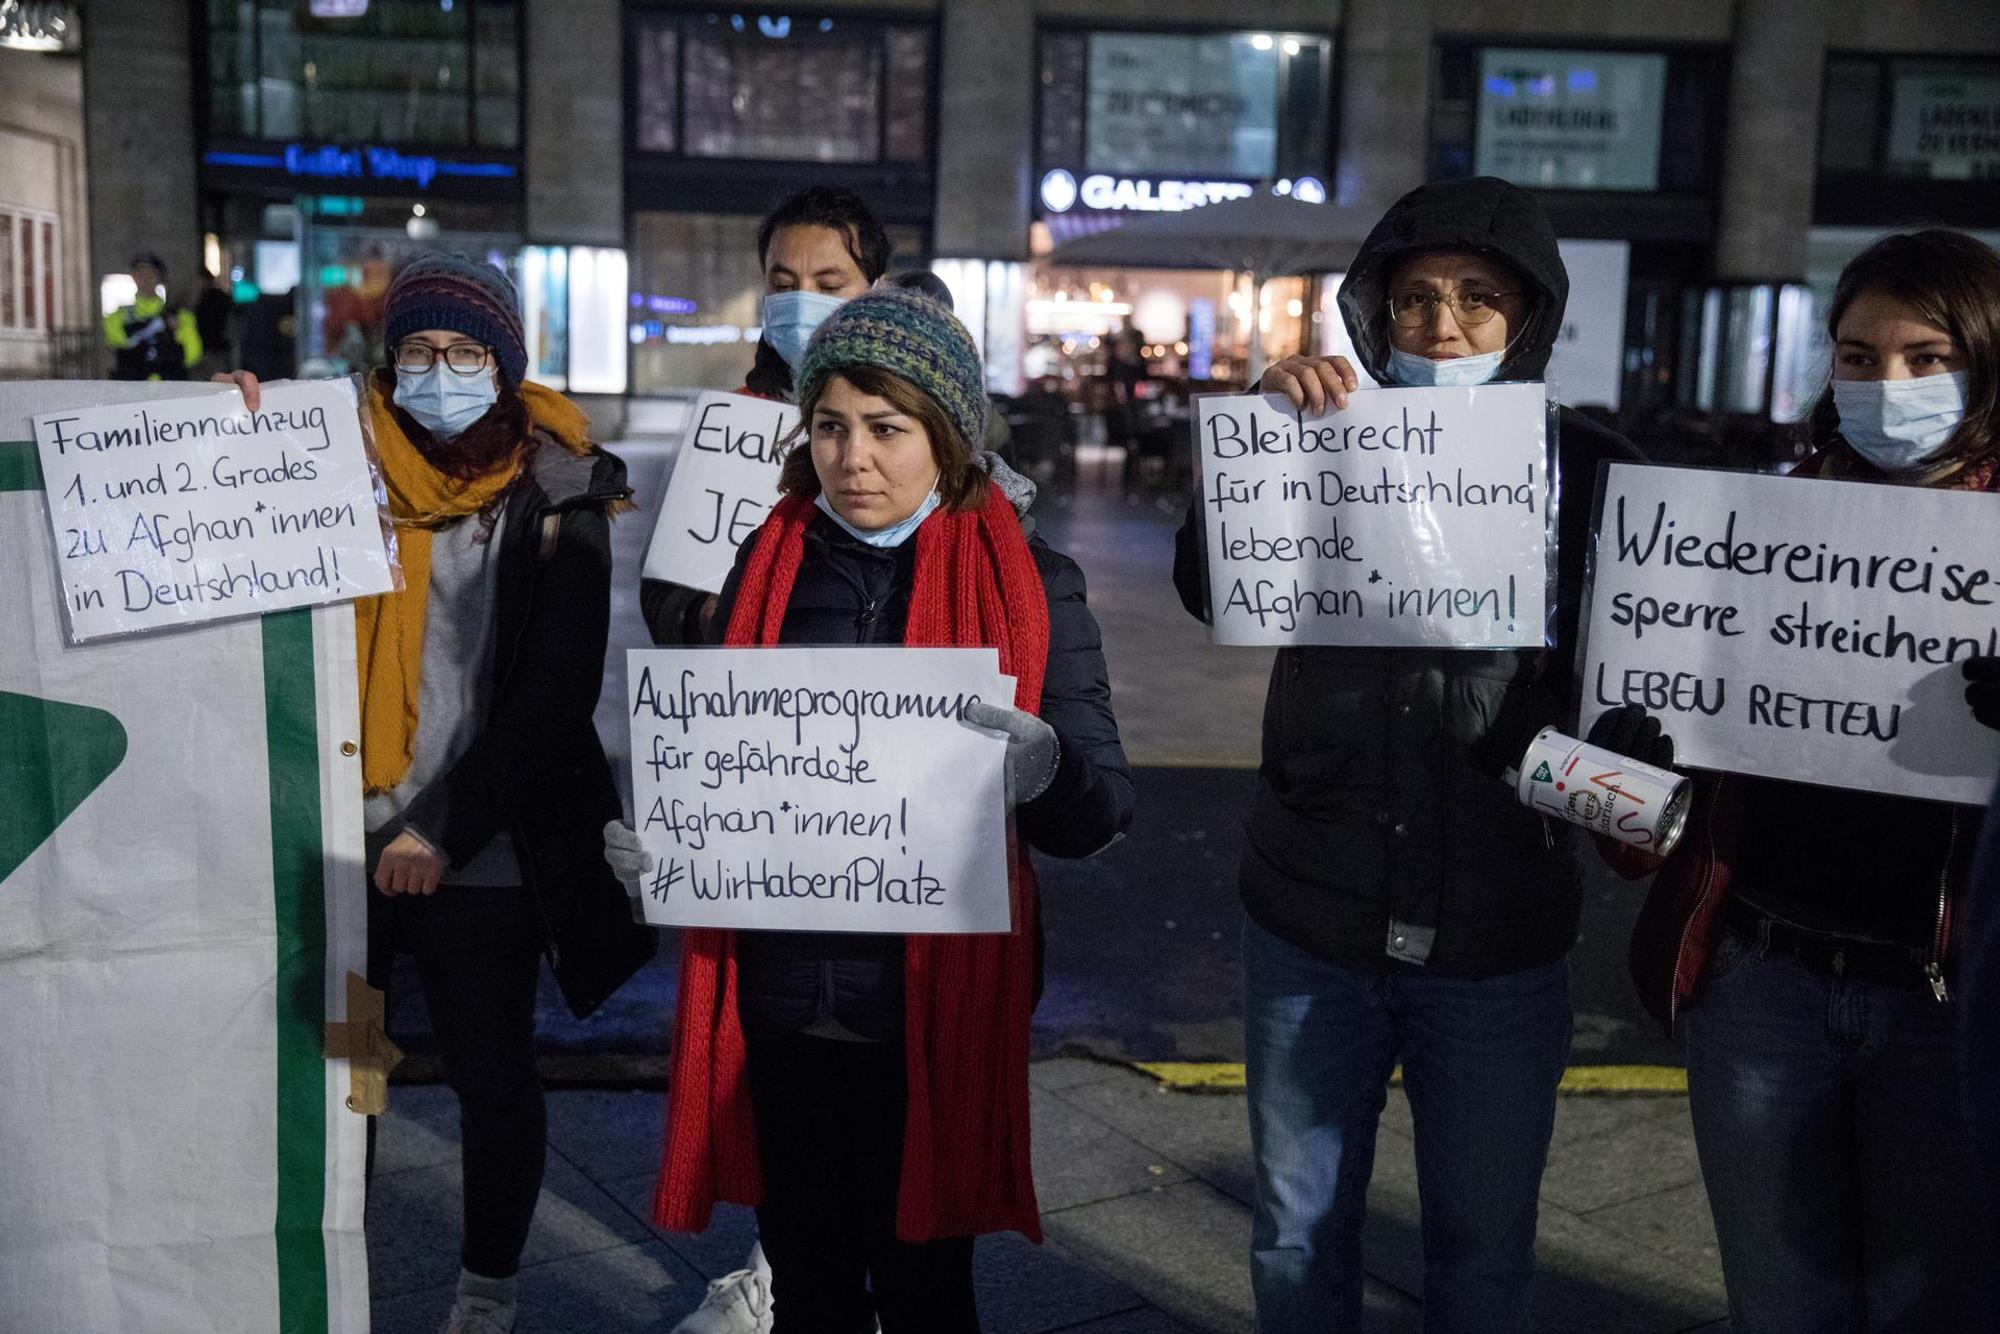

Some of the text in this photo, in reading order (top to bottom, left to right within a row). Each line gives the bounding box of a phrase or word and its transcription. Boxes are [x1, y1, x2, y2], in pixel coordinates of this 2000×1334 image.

[44, 406, 330, 455] Familiennachzug
[693, 402, 785, 466] Evak
[1207, 406, 1443, 459] Bleiberecht
[64, 451, 318, 506] 1. und 2. Grades
[1209, 463, 1536, 514] für in Deutschland
[66, 527, 108, 560] zu
[1221, 516, 1363, 561] lebende
[74, 546, 342, 612] in Deutschland!
[1610, 592, 1746, 639] sperre
[1595, 661, 1901, 743] LEBEN RETTEN
[646, 735, 877, 790] für gefährdete
[649, 856, 947, 906] #WirHabenPlatz
